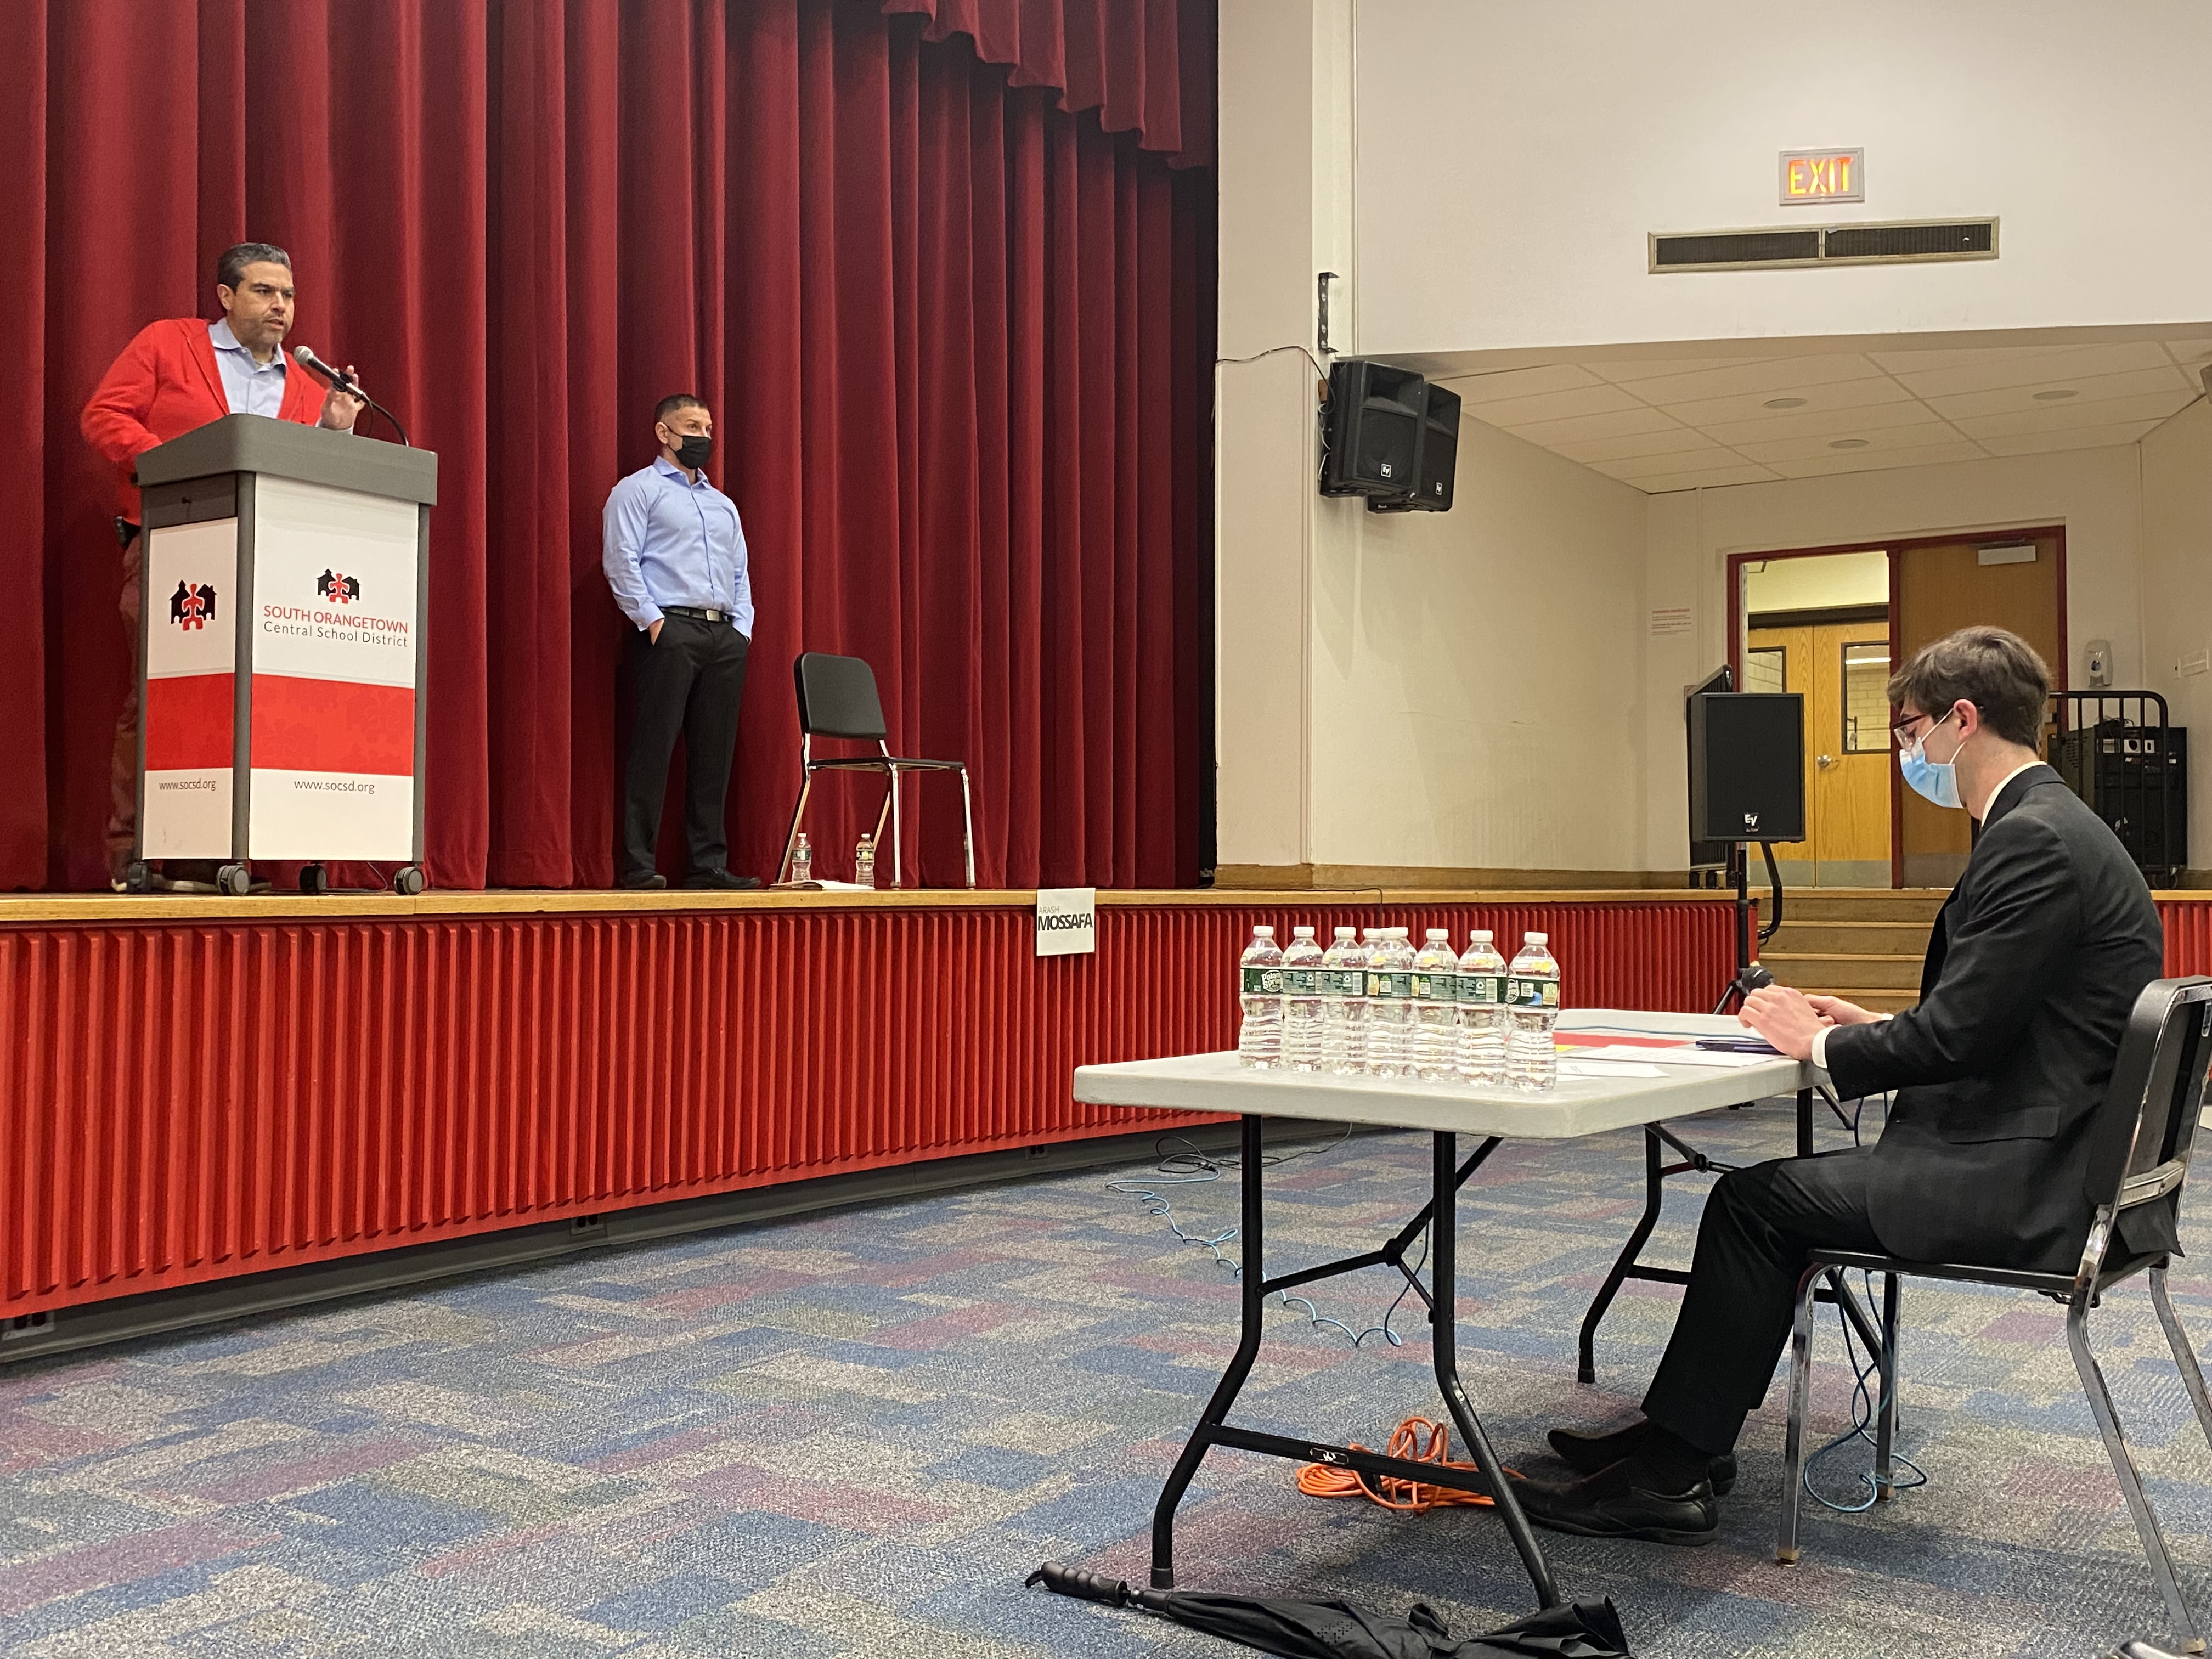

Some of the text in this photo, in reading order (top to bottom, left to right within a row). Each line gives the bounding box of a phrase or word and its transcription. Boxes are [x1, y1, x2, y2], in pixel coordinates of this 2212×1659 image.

[1789, 157, 1853, 194] EXIT
[264, 605, 408, 634] SOUTH ORANGETOWN
[264, 621, 407, 647] Central School District
[159, 778, 216, 791] www.socsd.org
[294, 780, 375, 794] www.socsd.org
[1745, 814, 1758, 826] EV
[1038, 913, 1093, 931] MOSSAFA
